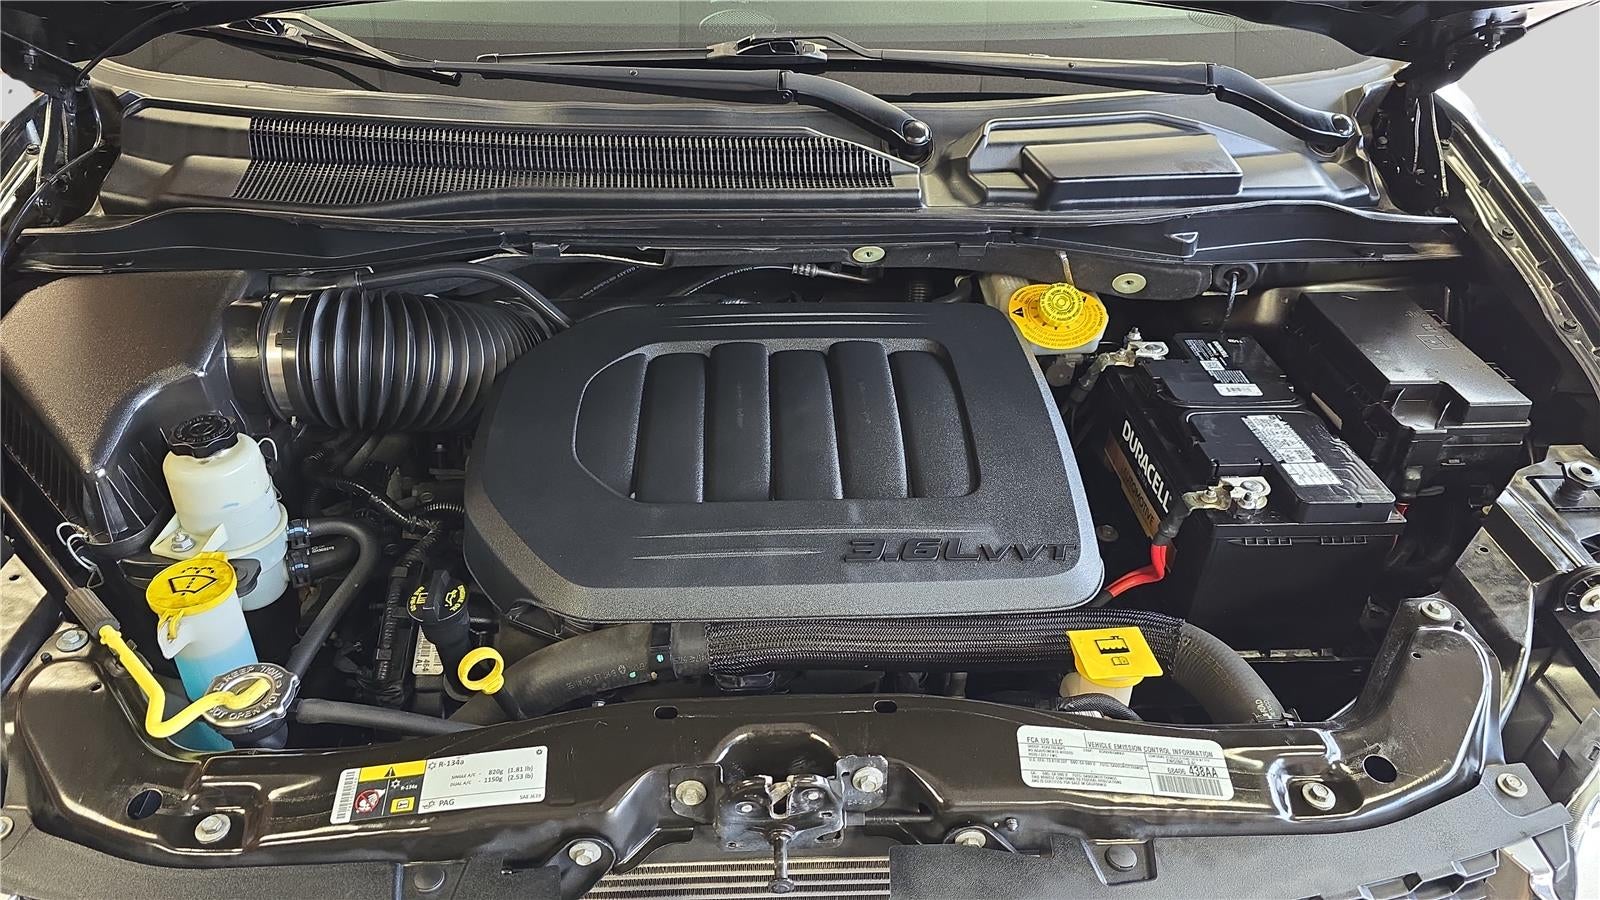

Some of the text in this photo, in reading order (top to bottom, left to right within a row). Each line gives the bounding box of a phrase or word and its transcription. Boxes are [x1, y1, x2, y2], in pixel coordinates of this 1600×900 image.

[1122, 420, 1170, 514] DURACELL
[229, 708, 260, 720] OPEN
[261, 692, 281, 709] HOT
[1087, 741, 1112, 750] VEHICLE
[1113, 743, 1142, 752] EMISSION
[1143, 746, 1170, 755] CONTROL
[1172, 749, 1213, 758] INFORMATION
[438, 759, 465, 768] R-134a
[488, 768, 504, 776] 820g
[1188, 765, 1219, 778] 438AA
[438, 798, 455, 807] PAG
